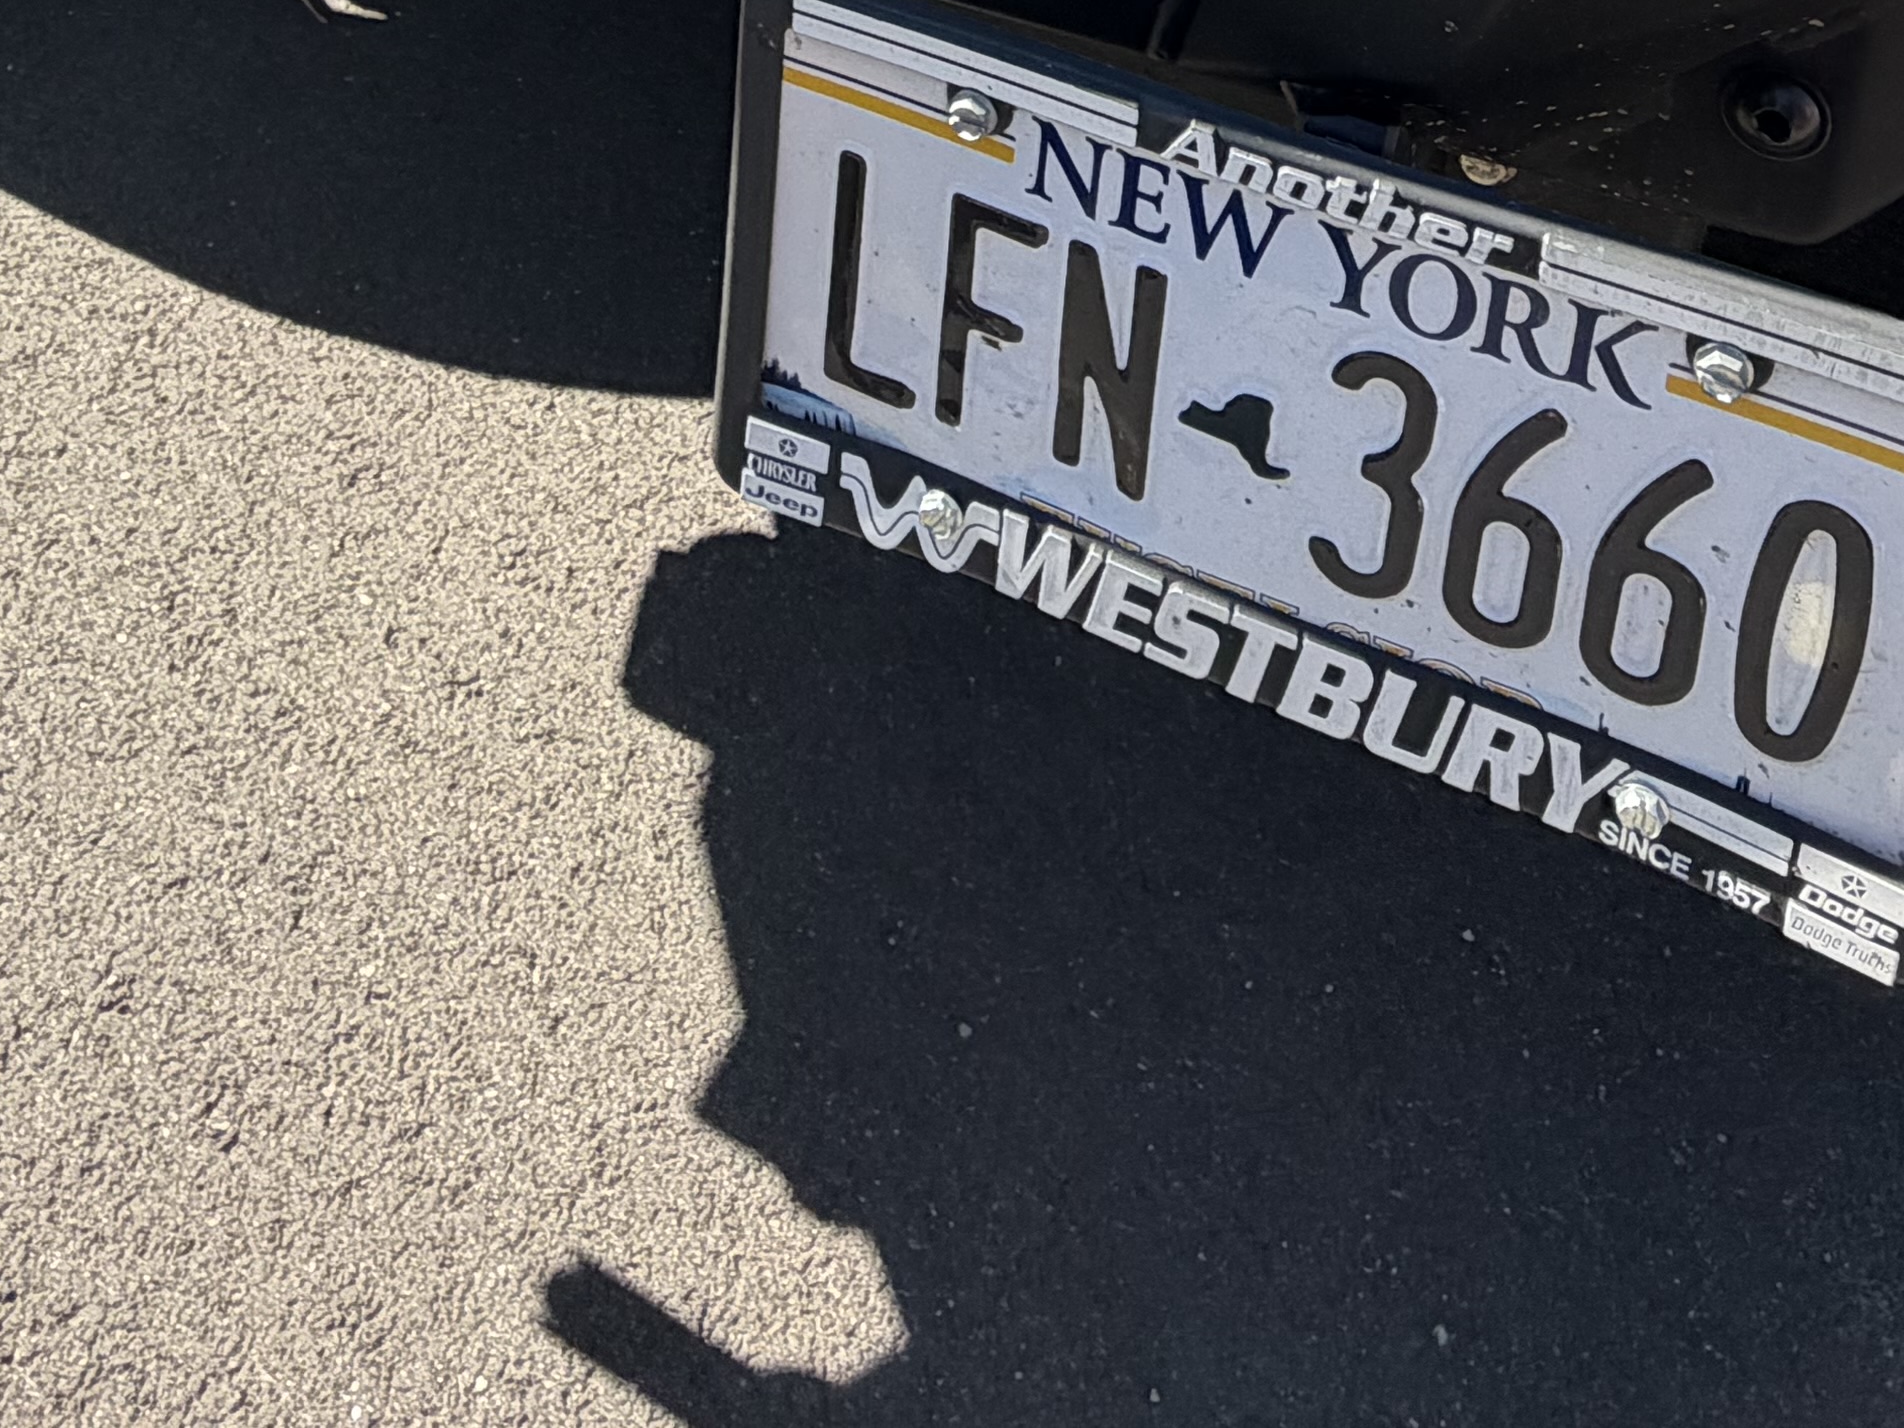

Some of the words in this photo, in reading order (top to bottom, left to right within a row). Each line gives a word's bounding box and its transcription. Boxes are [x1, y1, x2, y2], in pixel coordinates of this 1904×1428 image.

[1160, 119, 1514, 265] Another
[1026, 115, 1295, 280] NEW
[1317, 219, 1660, 410] YORK
[746, 485, 818, 518] Jeep
[748, 453, 817, 492] CHRYSLER
[823, 149, 1168, 502] LFN
[1308, 350, 1874, 764] 3660
[996, 507, 1633, 834] WESTBURY
[1598, 820, 1693, 881] SINCE
[1702, 869, 1772, 914] 1957
[1798, 883, 1900, 945] Dodge
[1791, 916, 1843, 951] Dodge
